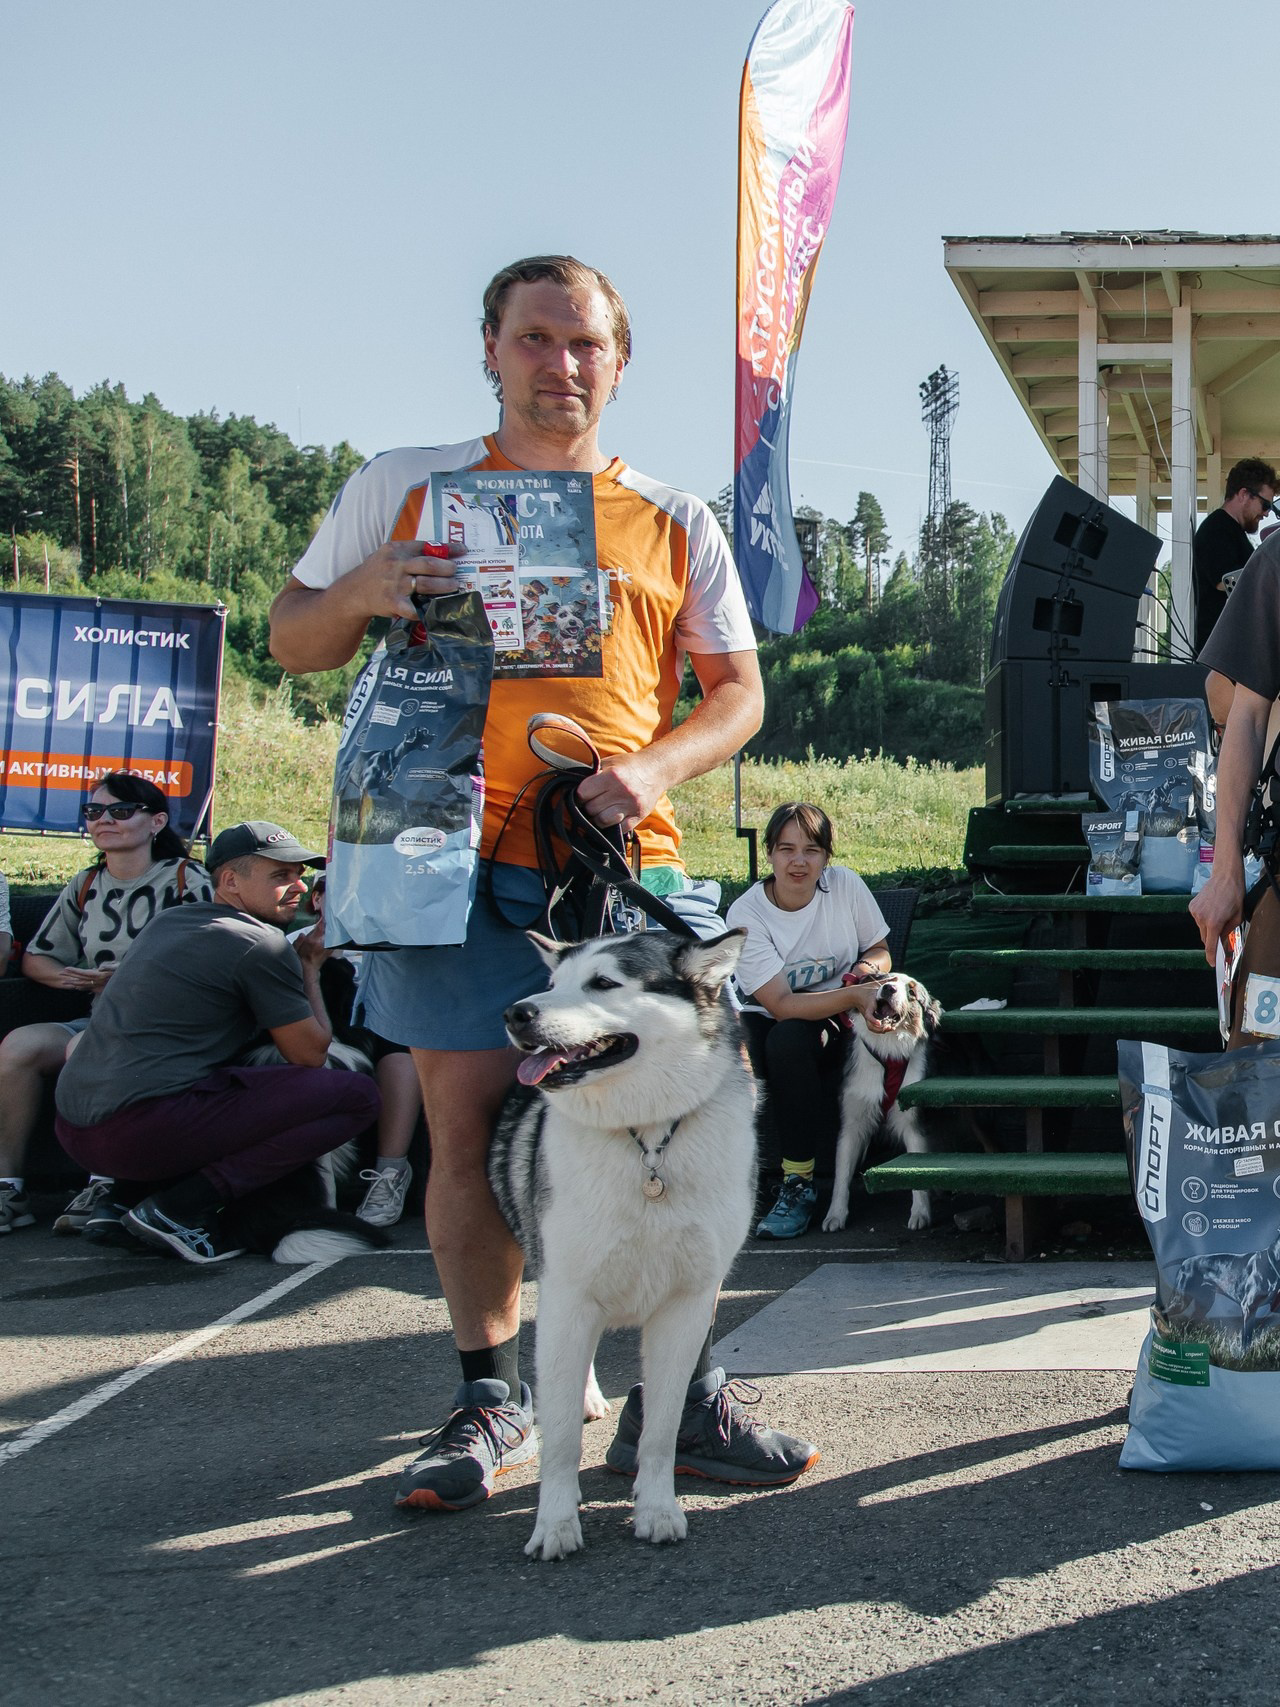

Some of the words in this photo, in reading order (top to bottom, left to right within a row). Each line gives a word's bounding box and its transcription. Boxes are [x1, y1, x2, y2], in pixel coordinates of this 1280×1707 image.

[518, 492, 562, 518] СТ
[74, 626, 190, 649] ХОЛИСТИК
[413, 668, 454, 684] СИЛА
[15, 677, 184, 729] СИЛА
[1120, 735, 1162, 747] ЖИВАЯ
[1164, 731, 1196, 743] СИЛА
[9, 761, 113, 780] АКТИВНЫХ
[1088, 822, 1123, 832] JJ-SPORT
[400, 836, 442, 844] ХОЛИСТИК
[405, 864, 425, 876] 2,5
[787, 965, 828, 987] 171
[1184, 1121, 1267, 1145] ЖИВАЯ
[1183, 1143, 1204, 1152] КОРМ
[1204, 1146, 1218, 1155] ДЛЯ
[1219, 1143, 1267, 1155] СПОРТИВНЫХ
[1144, 1105, 1164, 1213] СПОРТ
